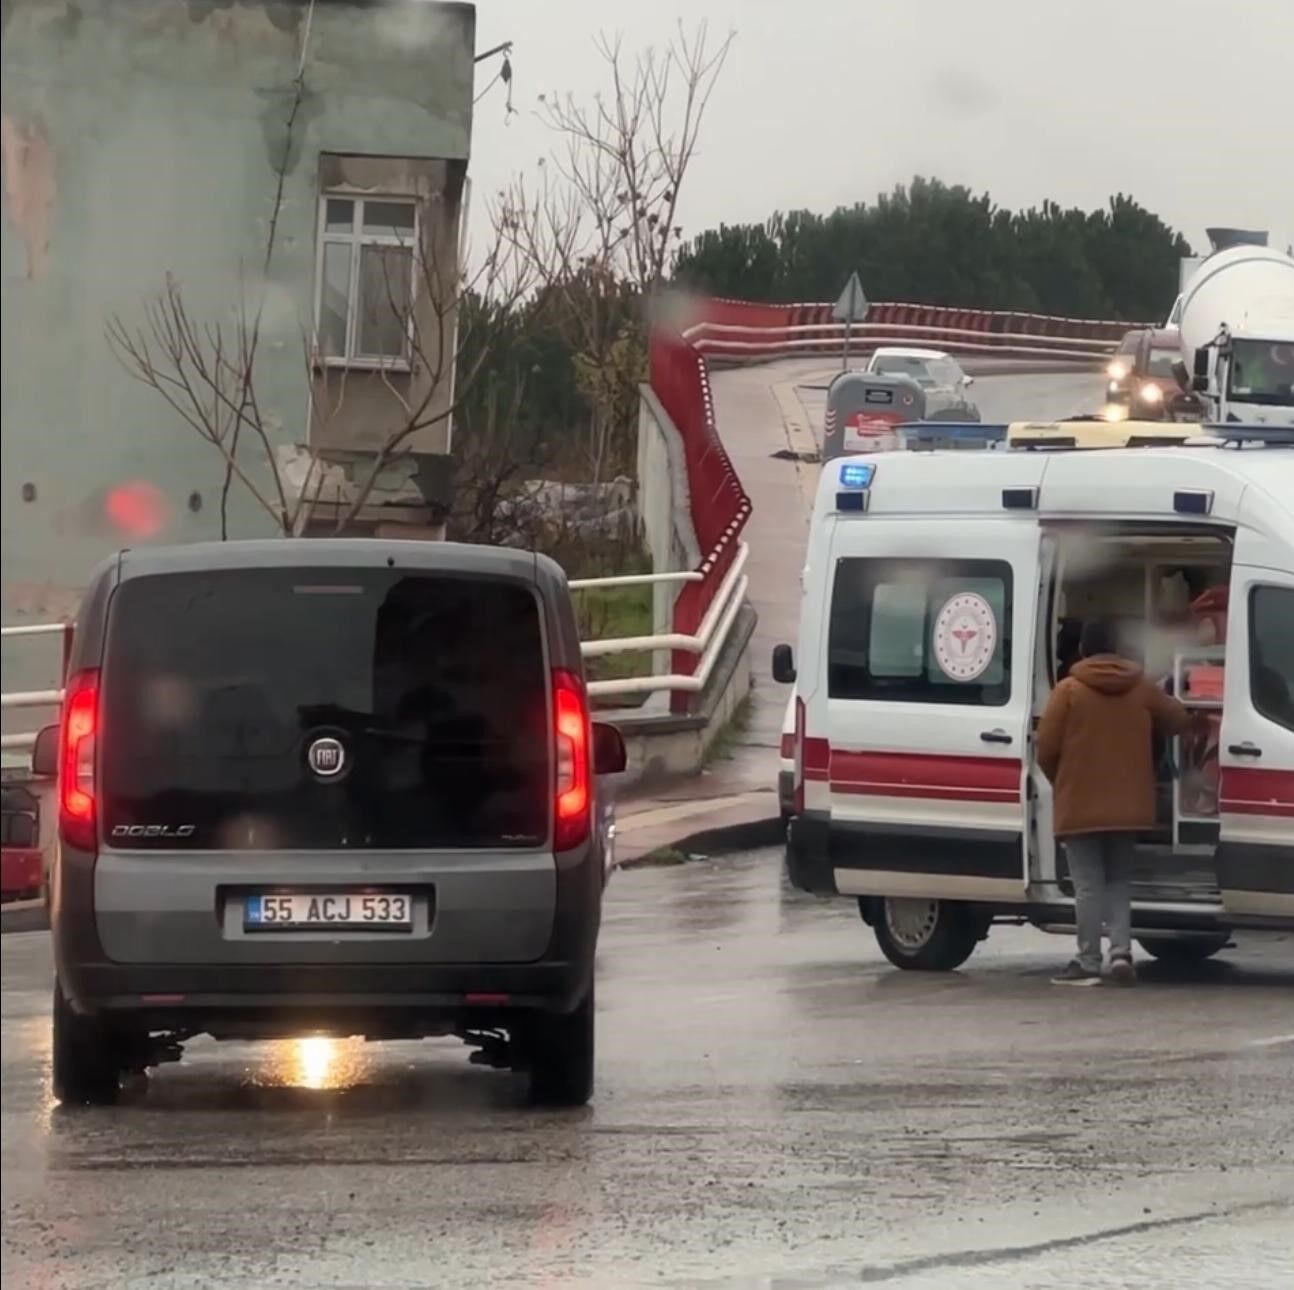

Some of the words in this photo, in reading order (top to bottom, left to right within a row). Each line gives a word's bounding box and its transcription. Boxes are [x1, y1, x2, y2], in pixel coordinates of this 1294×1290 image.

[112, 825, 195, 837] DOBLO
[263, 898, 293, 921] 55
[307, 898, 351, 921] ACJ
[362, 898, 405, 921] 533
